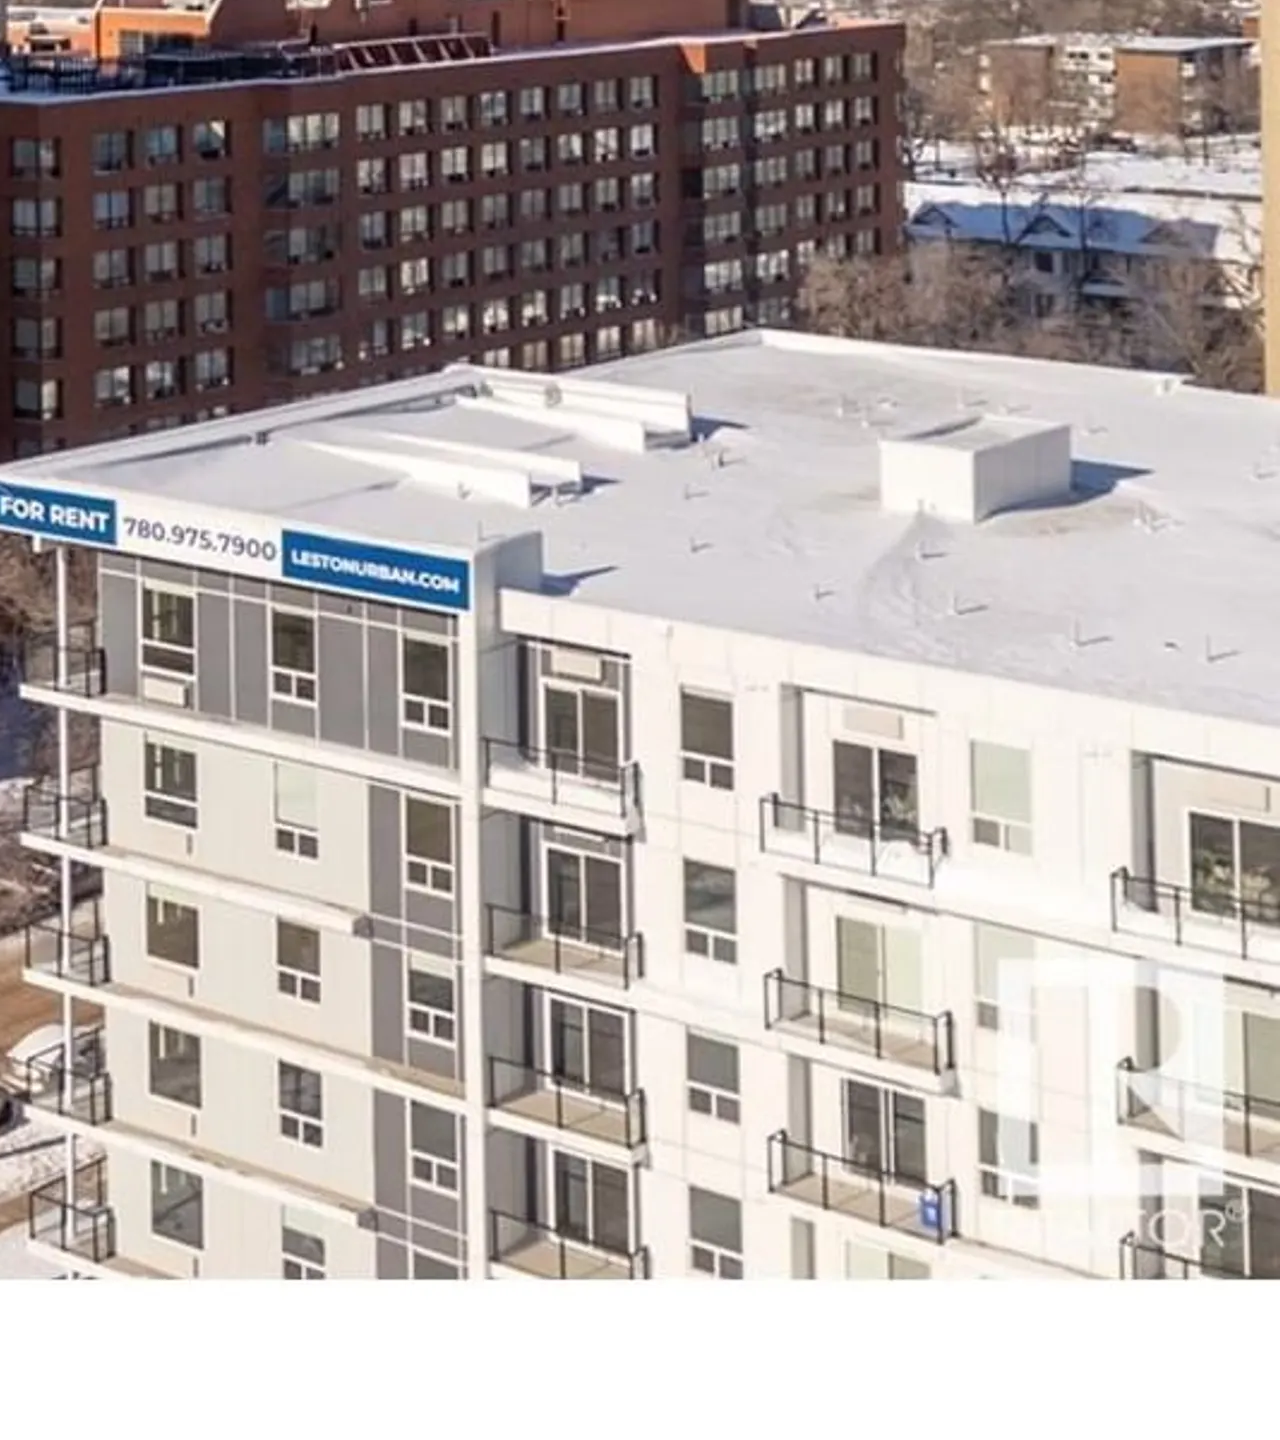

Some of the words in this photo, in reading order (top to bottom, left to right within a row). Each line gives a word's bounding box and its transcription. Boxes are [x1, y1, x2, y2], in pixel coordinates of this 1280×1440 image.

[0, 495, 46, 522] FOR
[49, 503, 110, 533] RENT
[123, 517, 277, 561] 780.975.7900
[291, 549, 460, 593] LESTONURBAN.COM
